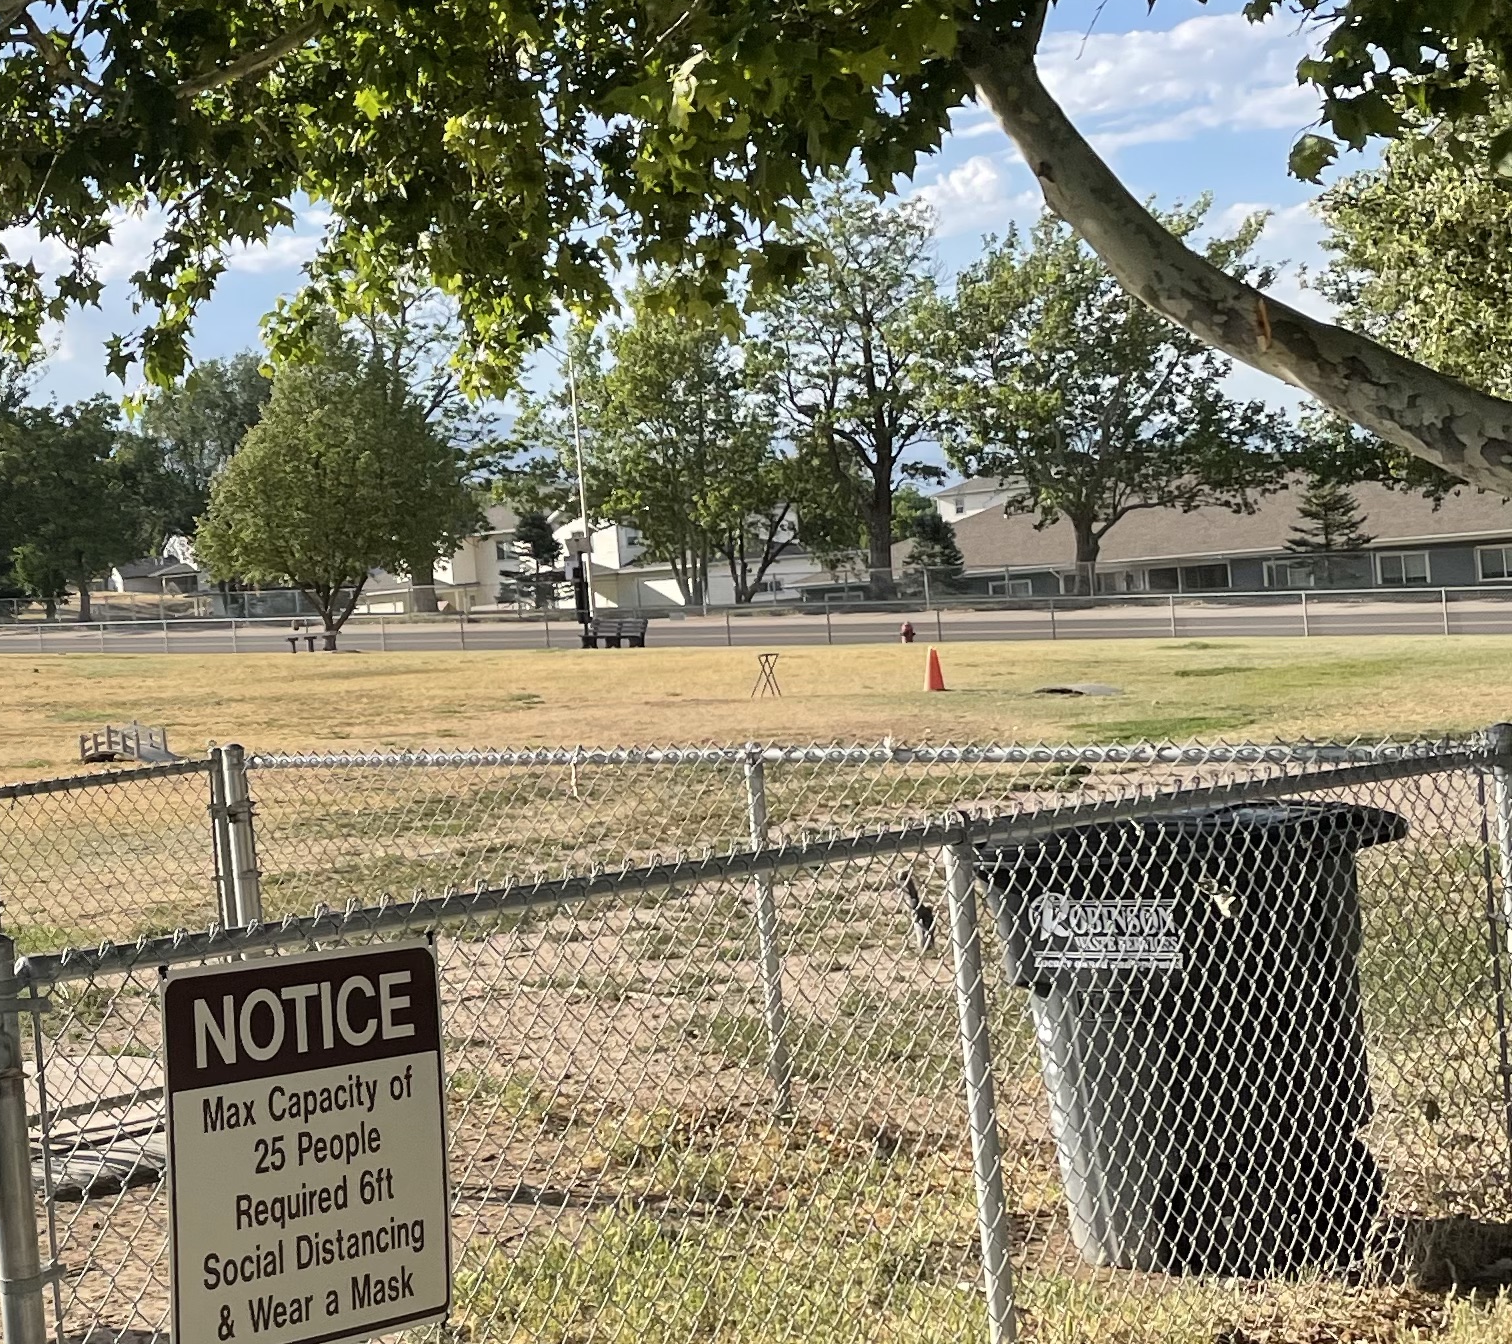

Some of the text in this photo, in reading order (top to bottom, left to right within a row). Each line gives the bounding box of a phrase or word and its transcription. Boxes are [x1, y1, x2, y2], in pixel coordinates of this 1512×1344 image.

[1031, 893, 1176, 940] ROBINSON
[193, 970, 415, 1069] NOTICE
[202, 1064, 413, 1133] Max Capacity of
[254, 1121, 381, 1174] 25 People
[236, 1168, 394, 1230] Required 6ft
[203, 1217, 425, 1290] Social Distancing
[218, 1265, 414, 1341] & Wear a Mask
